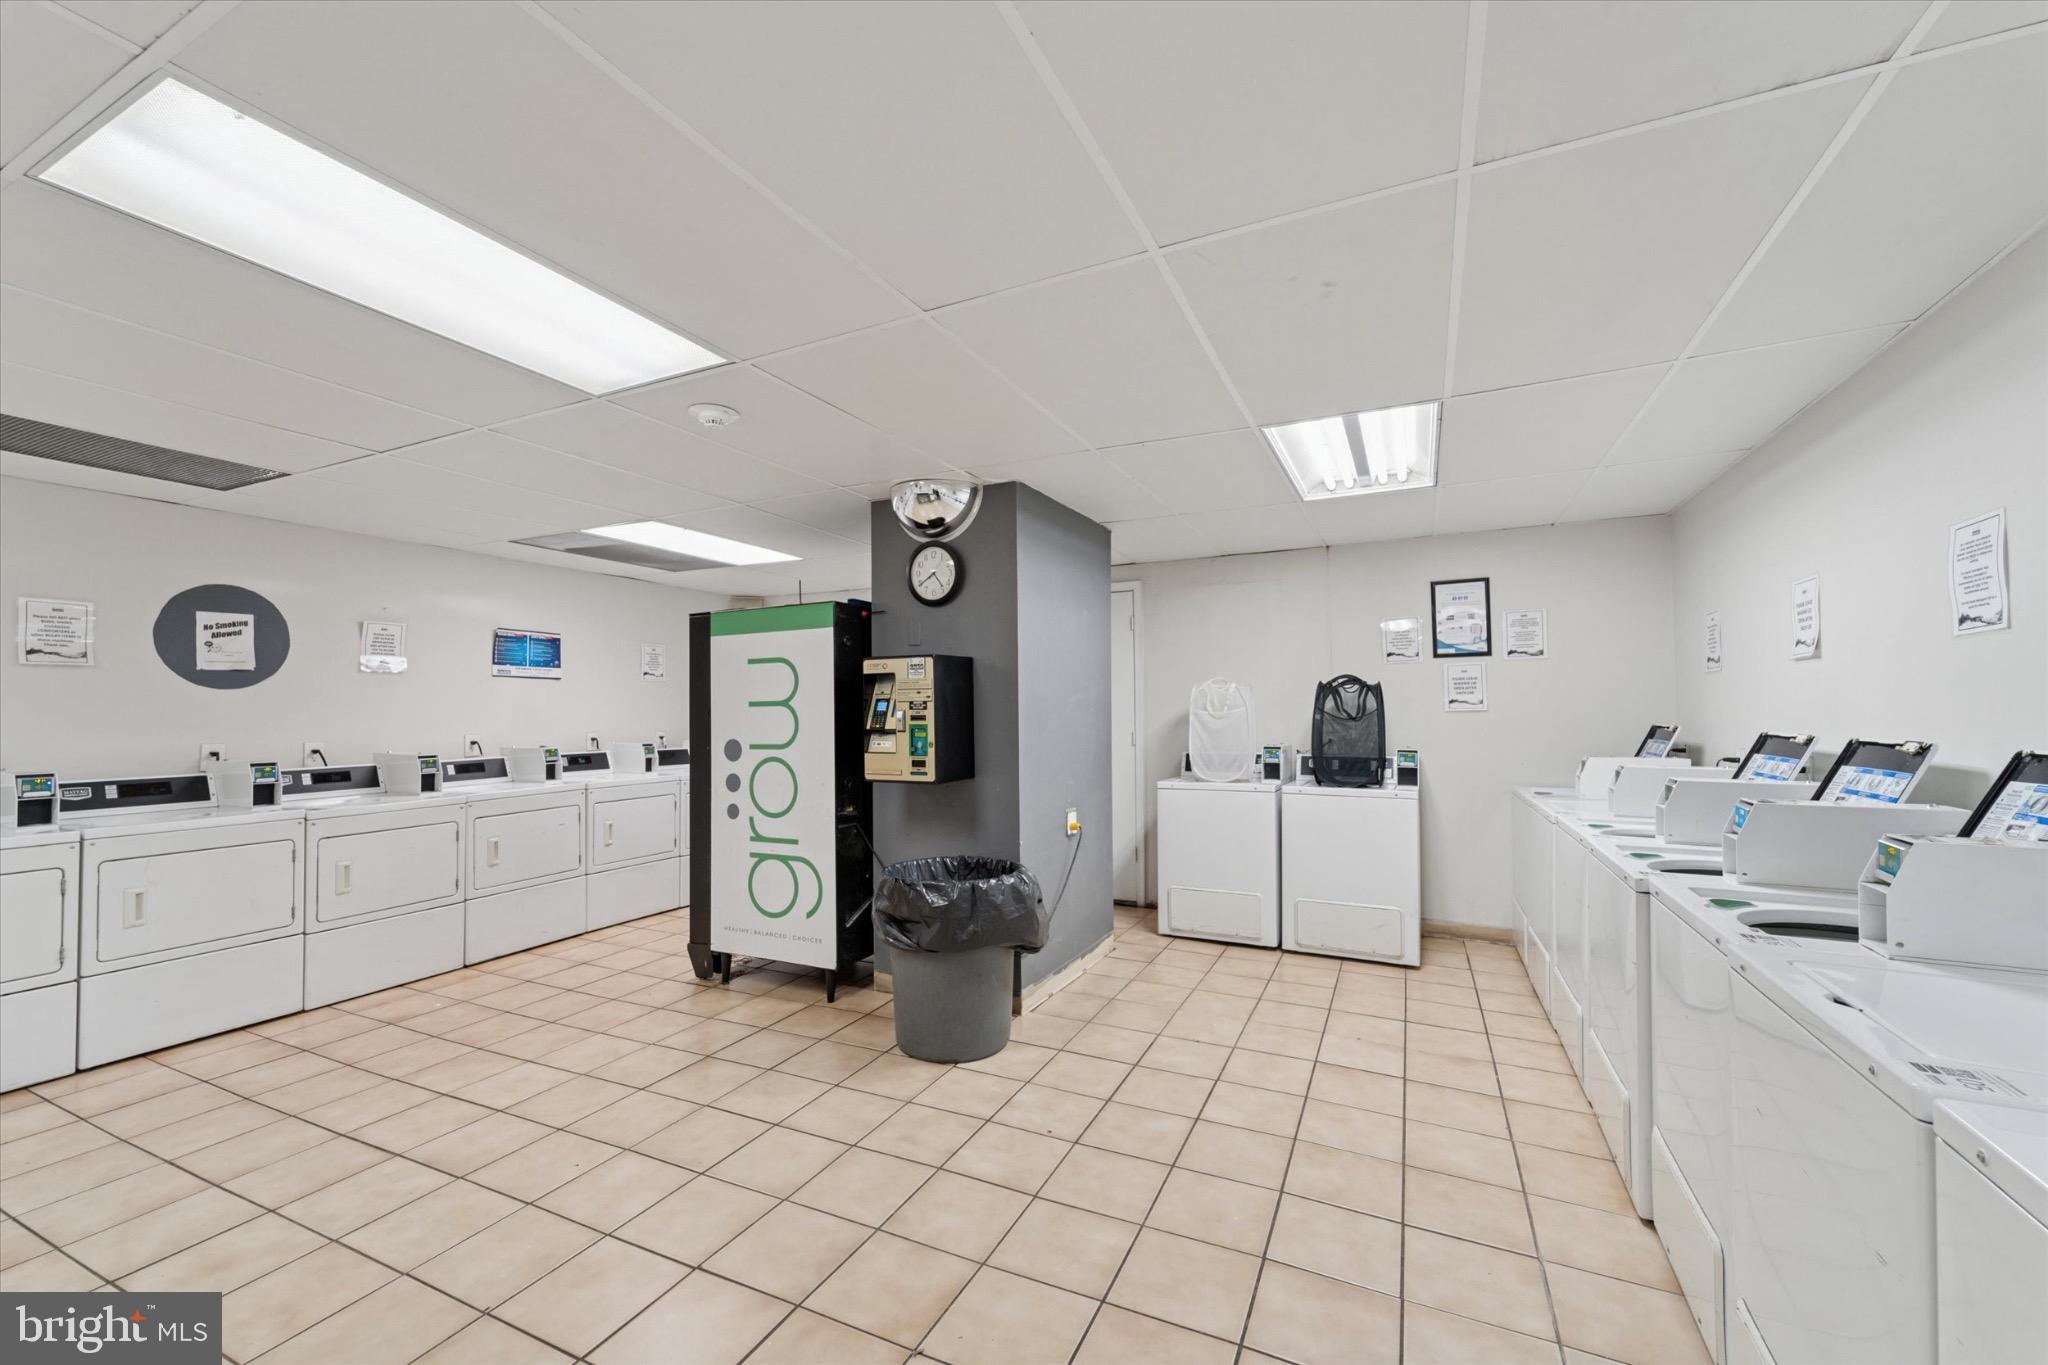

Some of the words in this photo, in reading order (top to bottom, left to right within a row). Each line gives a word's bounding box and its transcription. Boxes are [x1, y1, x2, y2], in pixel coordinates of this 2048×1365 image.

[215, 620, 248, 629] Smoking
[211, 629, 242, 638] Allowed
[747, 656, 824, 919] grow
[724, 925, 749, 935] HEALTHY
[753, 930, 788, 940] BALANCED
[792, 934, 823, 945] CHOICES
